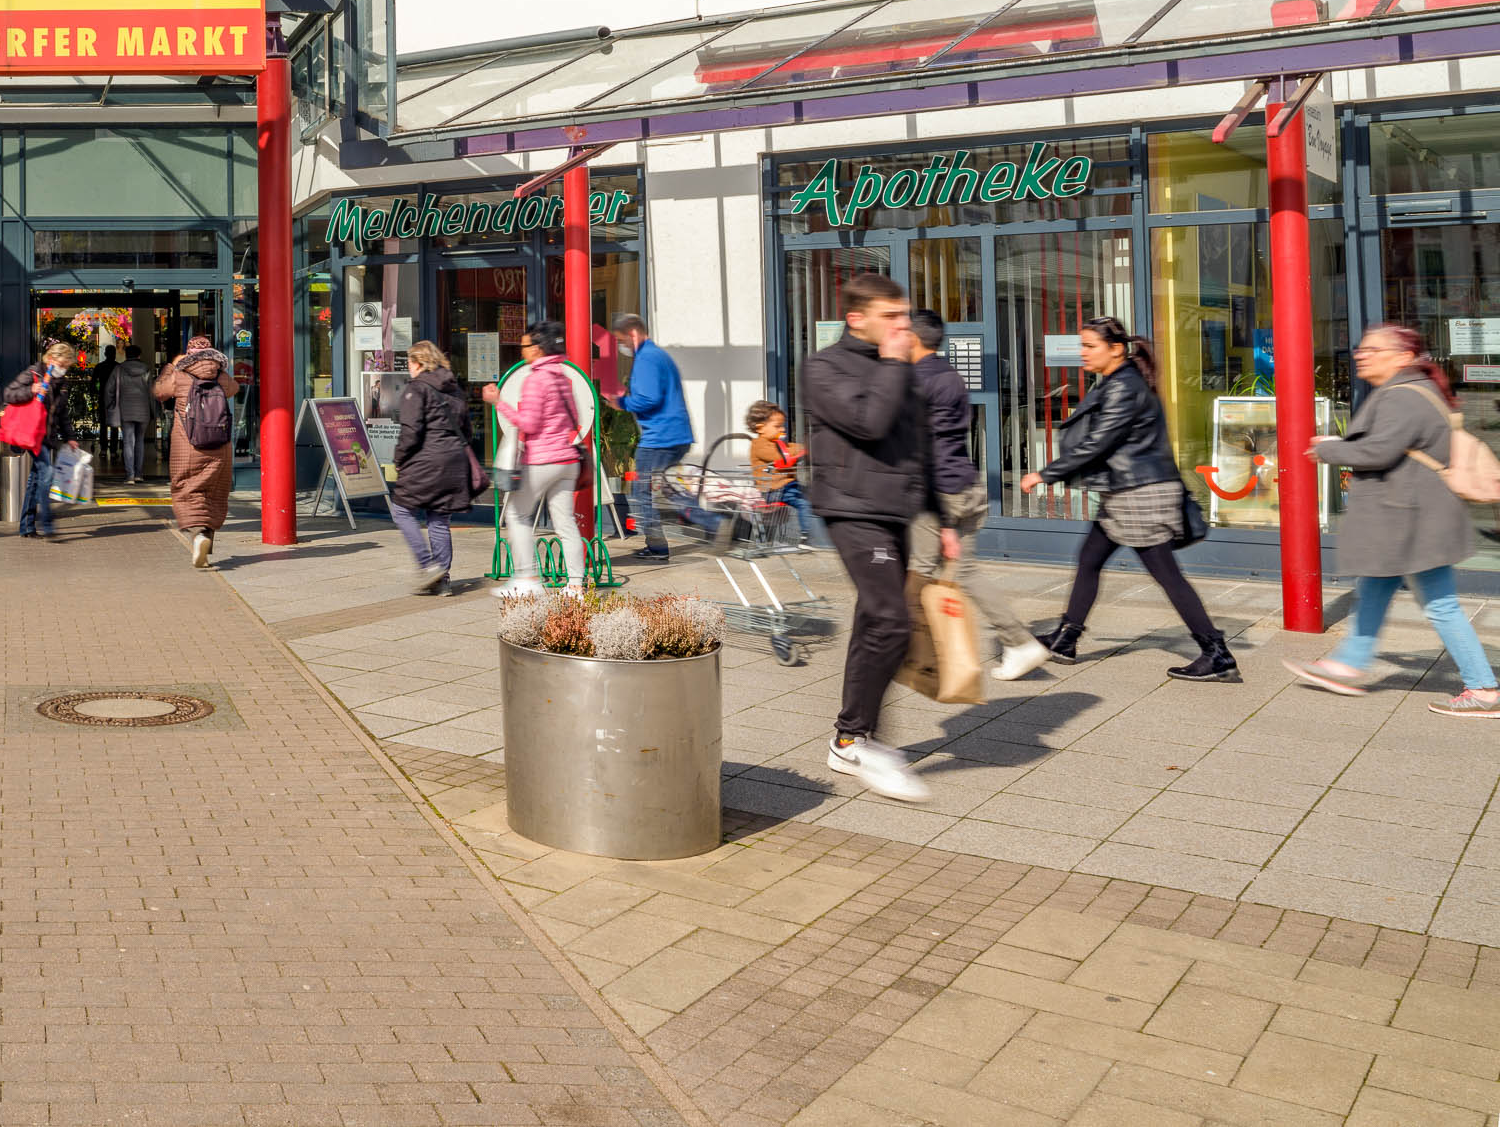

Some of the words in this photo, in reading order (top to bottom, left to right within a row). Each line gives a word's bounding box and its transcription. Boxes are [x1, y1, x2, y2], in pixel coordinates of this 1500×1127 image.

[116, 26, 249, 56] MARKT
[790, 141, 1092, 226] Apotheke
[325, 189, 630, 252] Melchendorer
